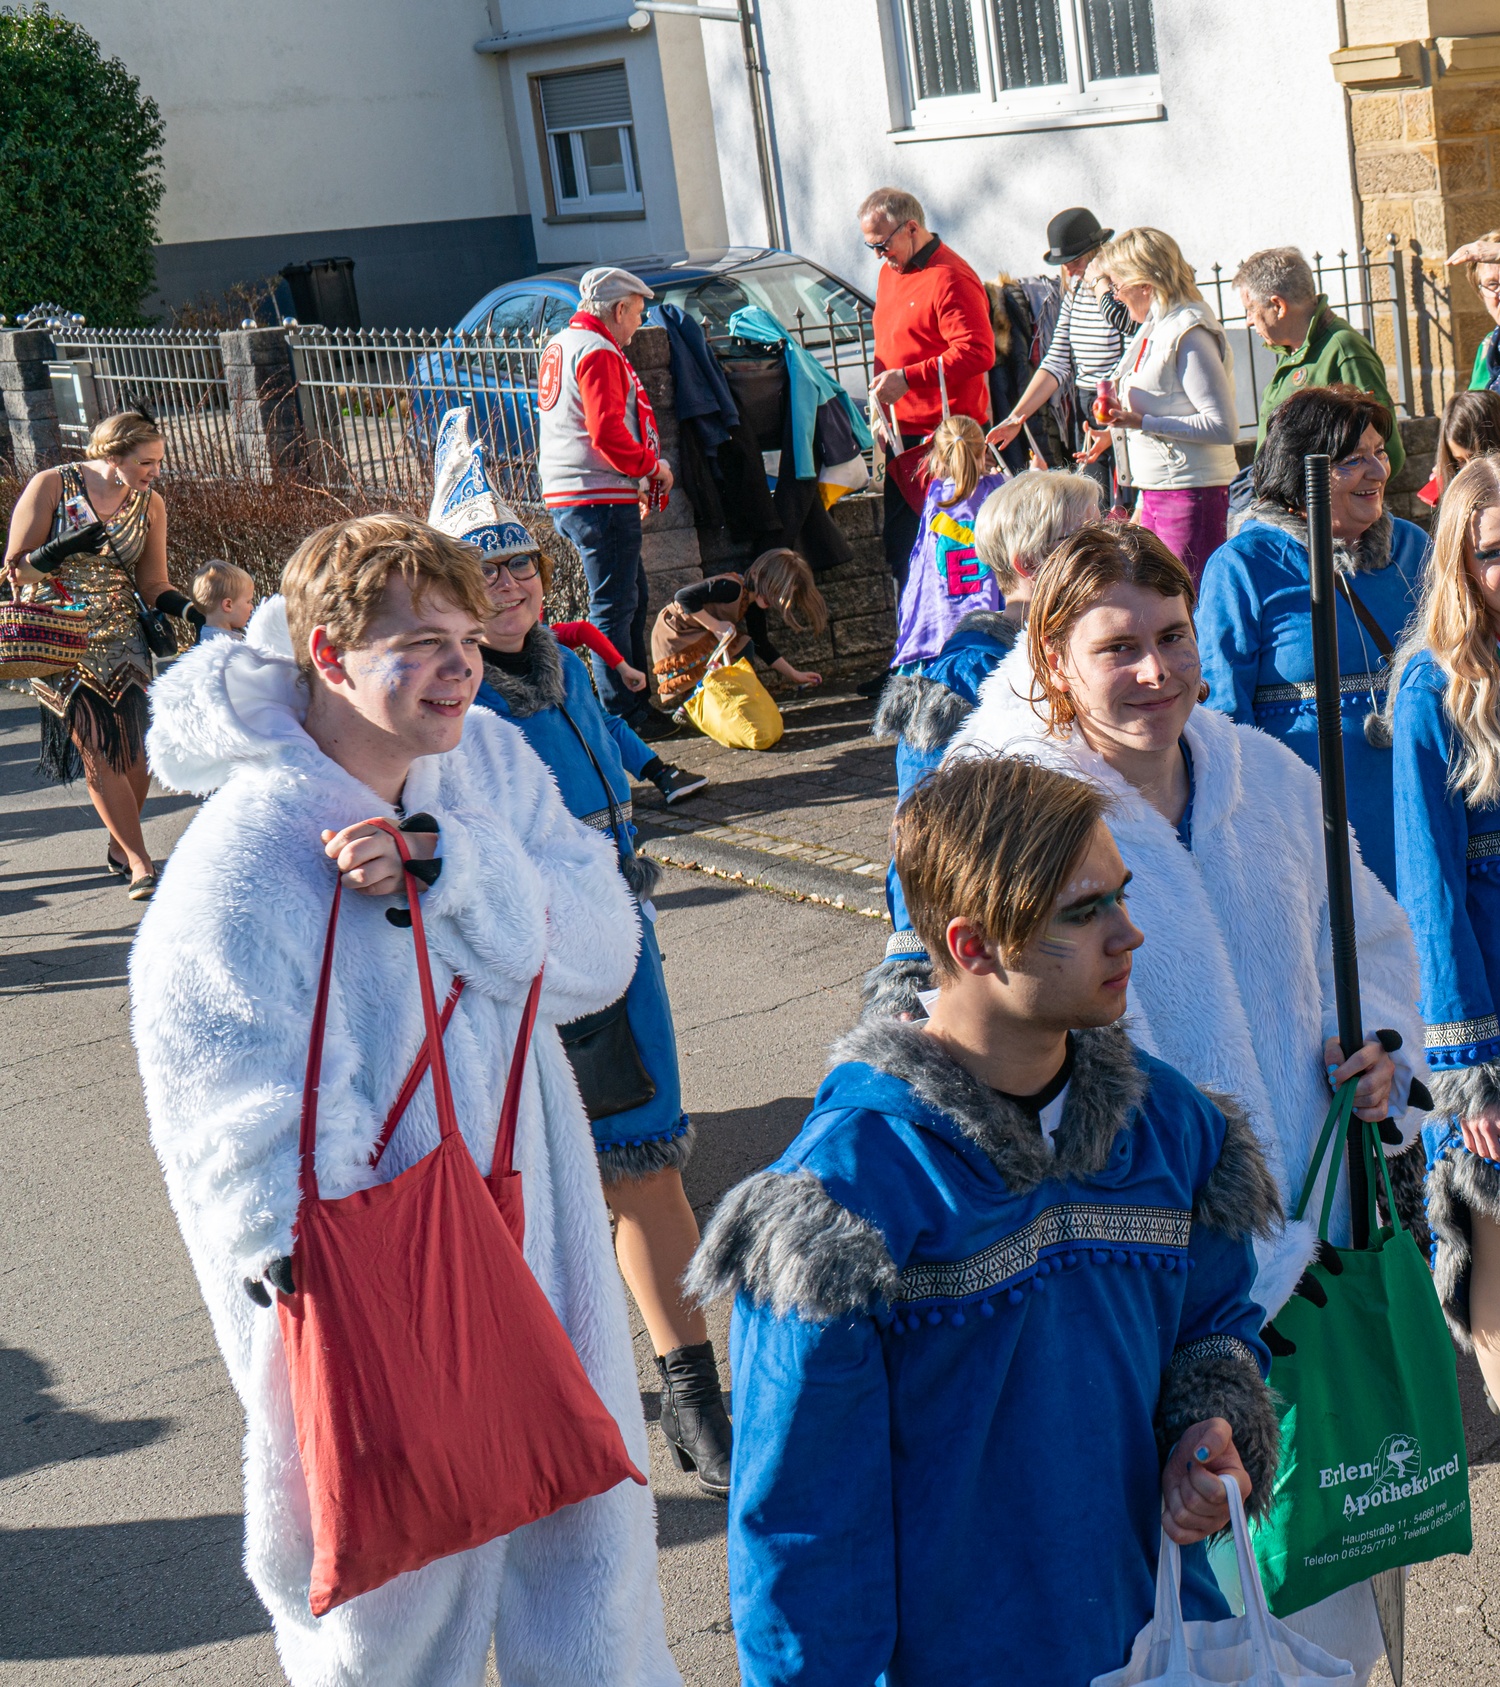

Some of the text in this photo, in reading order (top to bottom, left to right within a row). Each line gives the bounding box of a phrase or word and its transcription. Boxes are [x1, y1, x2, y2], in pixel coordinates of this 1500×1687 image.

[1319, 1462, 1379, 1488] Erlen-
[1342, 1453, 1460, 1516] Apotheke Irrel
[1303, 1553, 1339, 1566] Telefon
[1403, 1525, 1430, 1540] Telefax
[1342, 1523, 1395, 1545] Hauptstraße
